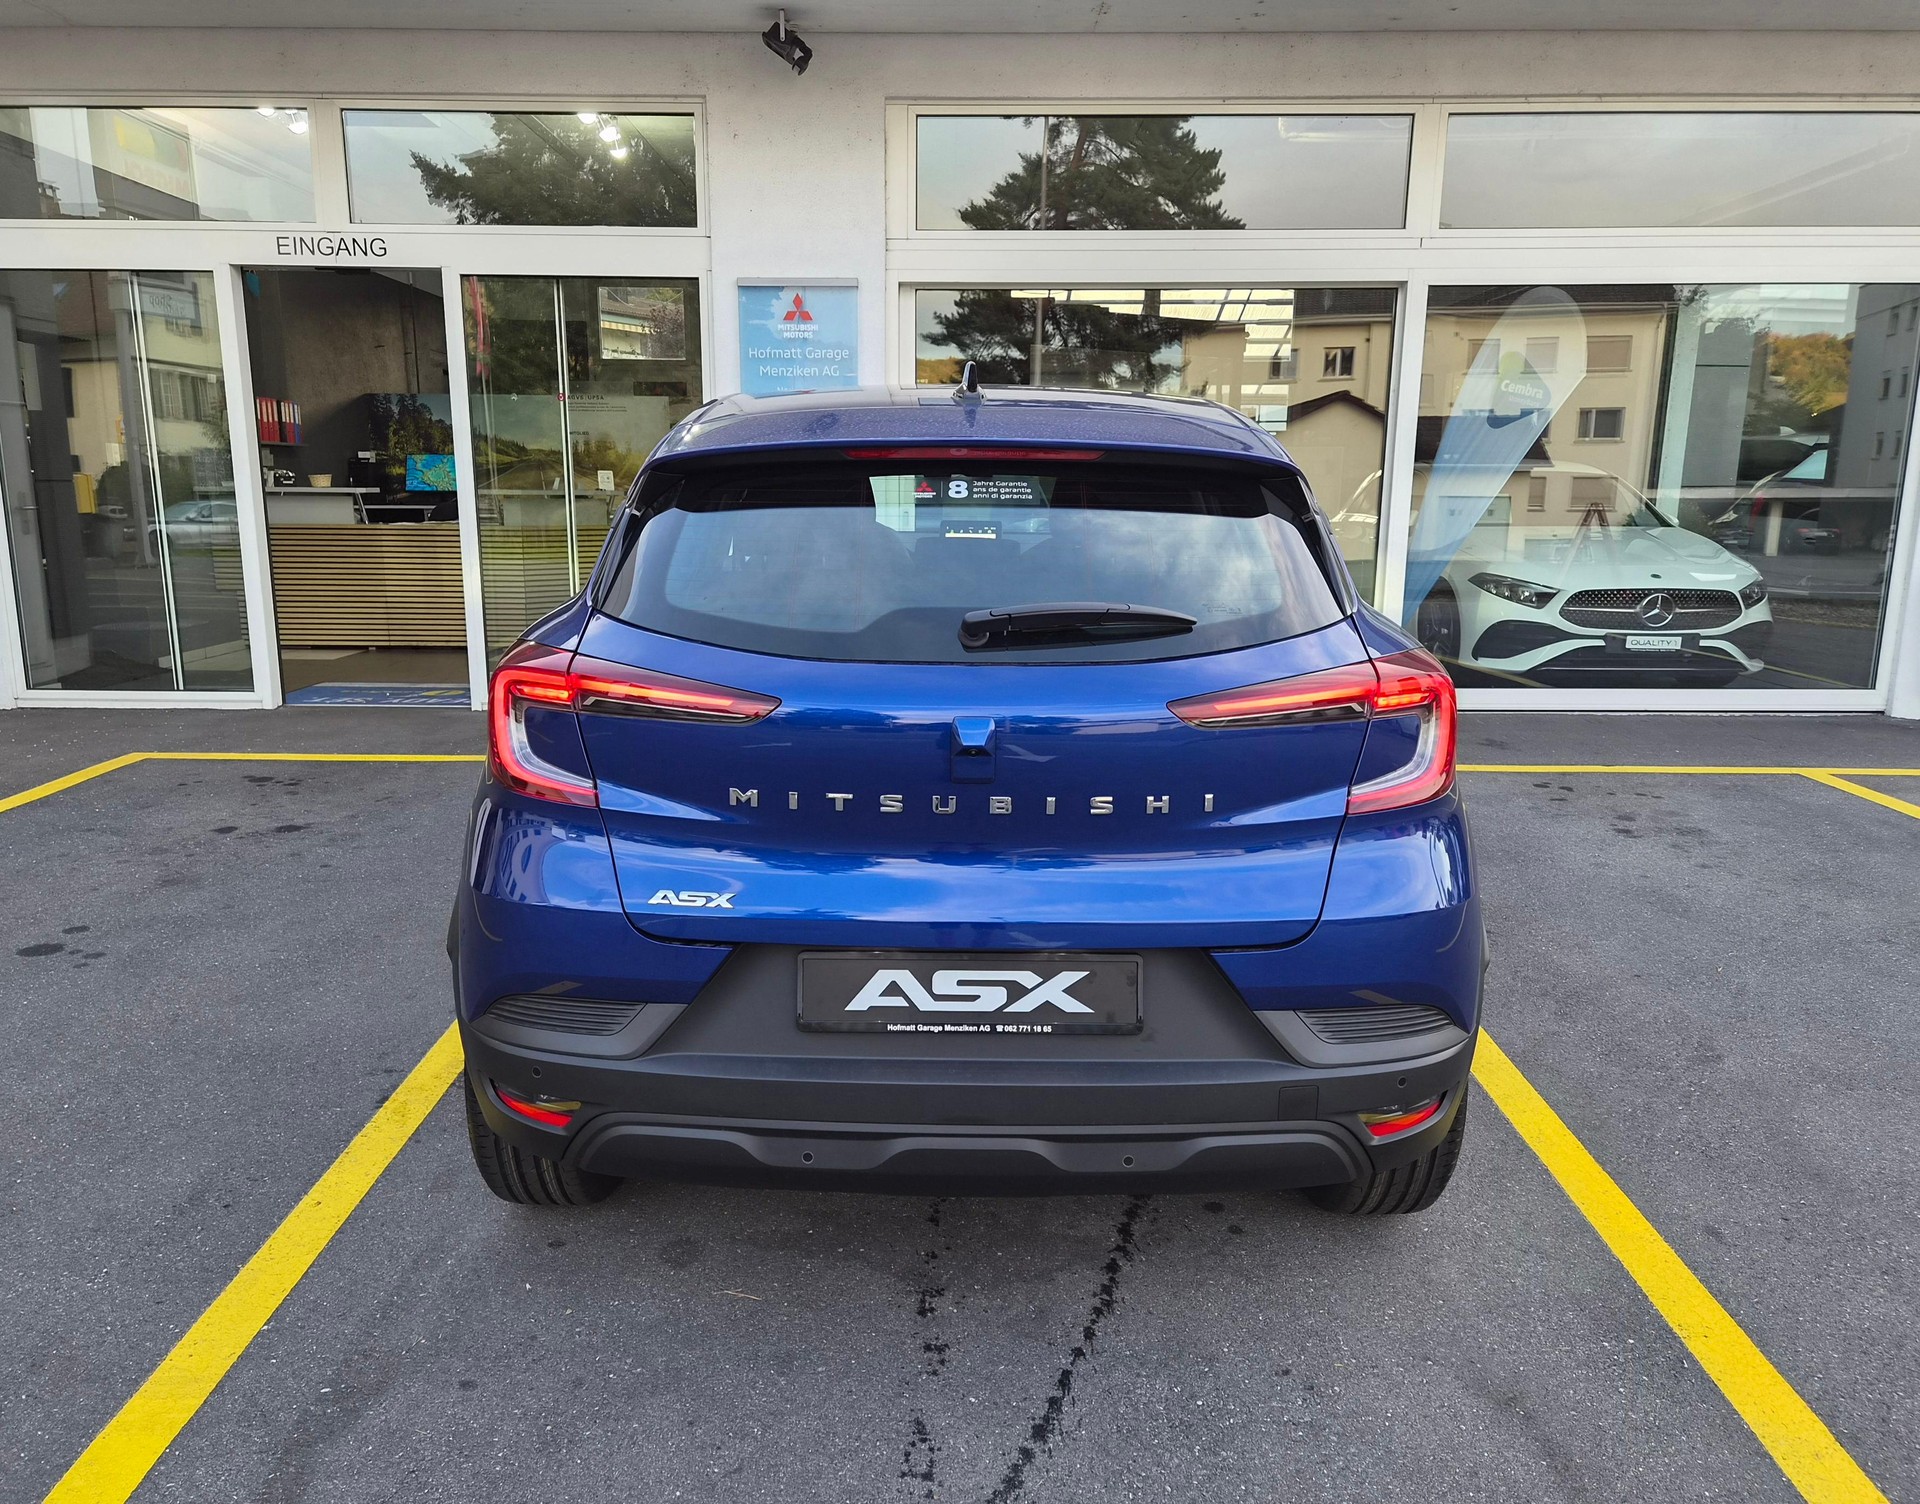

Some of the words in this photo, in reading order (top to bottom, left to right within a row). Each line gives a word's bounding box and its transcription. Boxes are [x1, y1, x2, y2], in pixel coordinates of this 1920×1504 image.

[276, 236, 387, 257] EINGANG
[783, 331, 813, 339] MOTORS
[748, 346, 802, 359] Hofmatt
[805, 347, 849, 361] Garage
[759, 365, 819, 377] Menziken
[822, 365, 840, 377] AG
[1500, 379, 1544, 399] Cembra
[948, 480, 969, 499] 8
[729, 787, 1215, 816] MITSUBISHI
[647, 889, 737, 910] ASX
[843, 969, 1096, 1013] ASX
[917, 1024, 943, 1033] Garage
[944, 1024, 978, 1032] Menziken
[979, 1024, 991, 1032] AG
[1042, 1025, 1052, 1033] 65
